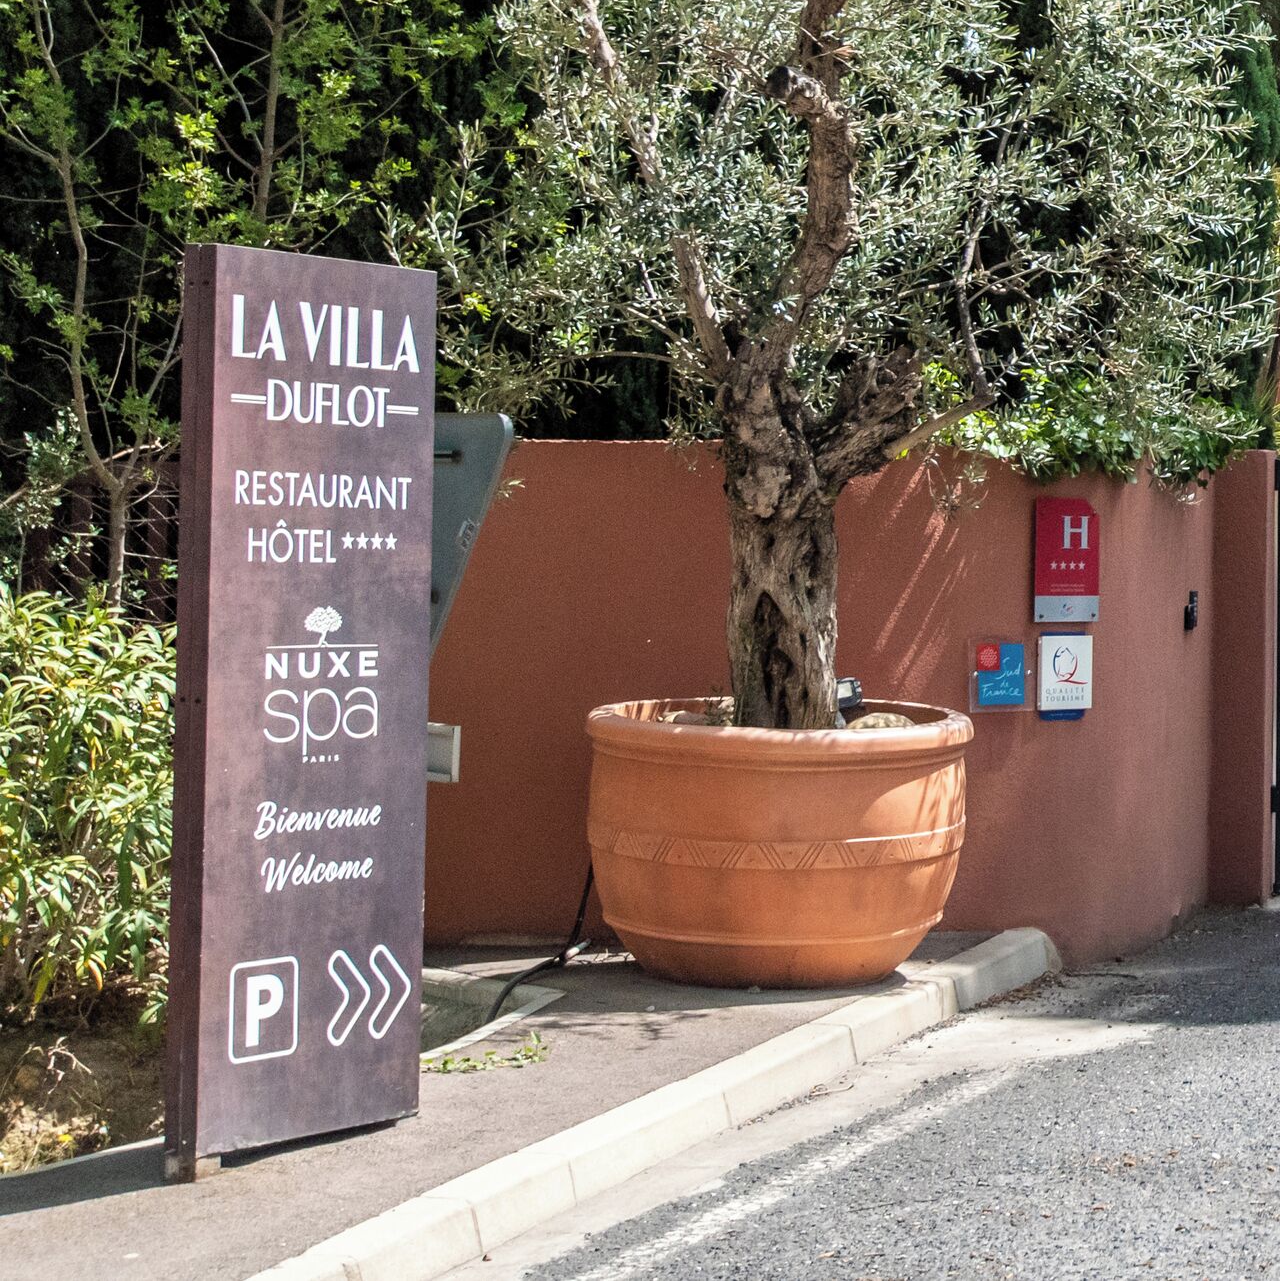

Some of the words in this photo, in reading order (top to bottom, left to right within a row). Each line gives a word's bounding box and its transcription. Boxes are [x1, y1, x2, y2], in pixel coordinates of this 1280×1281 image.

[231, 294, 287, 361] LA
[299, 301, 420, 373] VILLA
[266, 379, 390, 428] DUFLOT
[234, 469, 412, 510] RESTAURANT
[247, 519, 337, 564] HÔTEL
[1061, 515, 1090, 550] H
[264, 650, 379, 680] NUXE
[995, 656, 1022, 680] Sud
[981, 682, 1023, 699] France
[263, 686, 378, 756] spa
[302, 754, 340, 764] PARIS
[253, 801, 382, 840] Bienvenue
[260, 852, 373, 893] Welcome
[245, 974, 284, 1047] P
